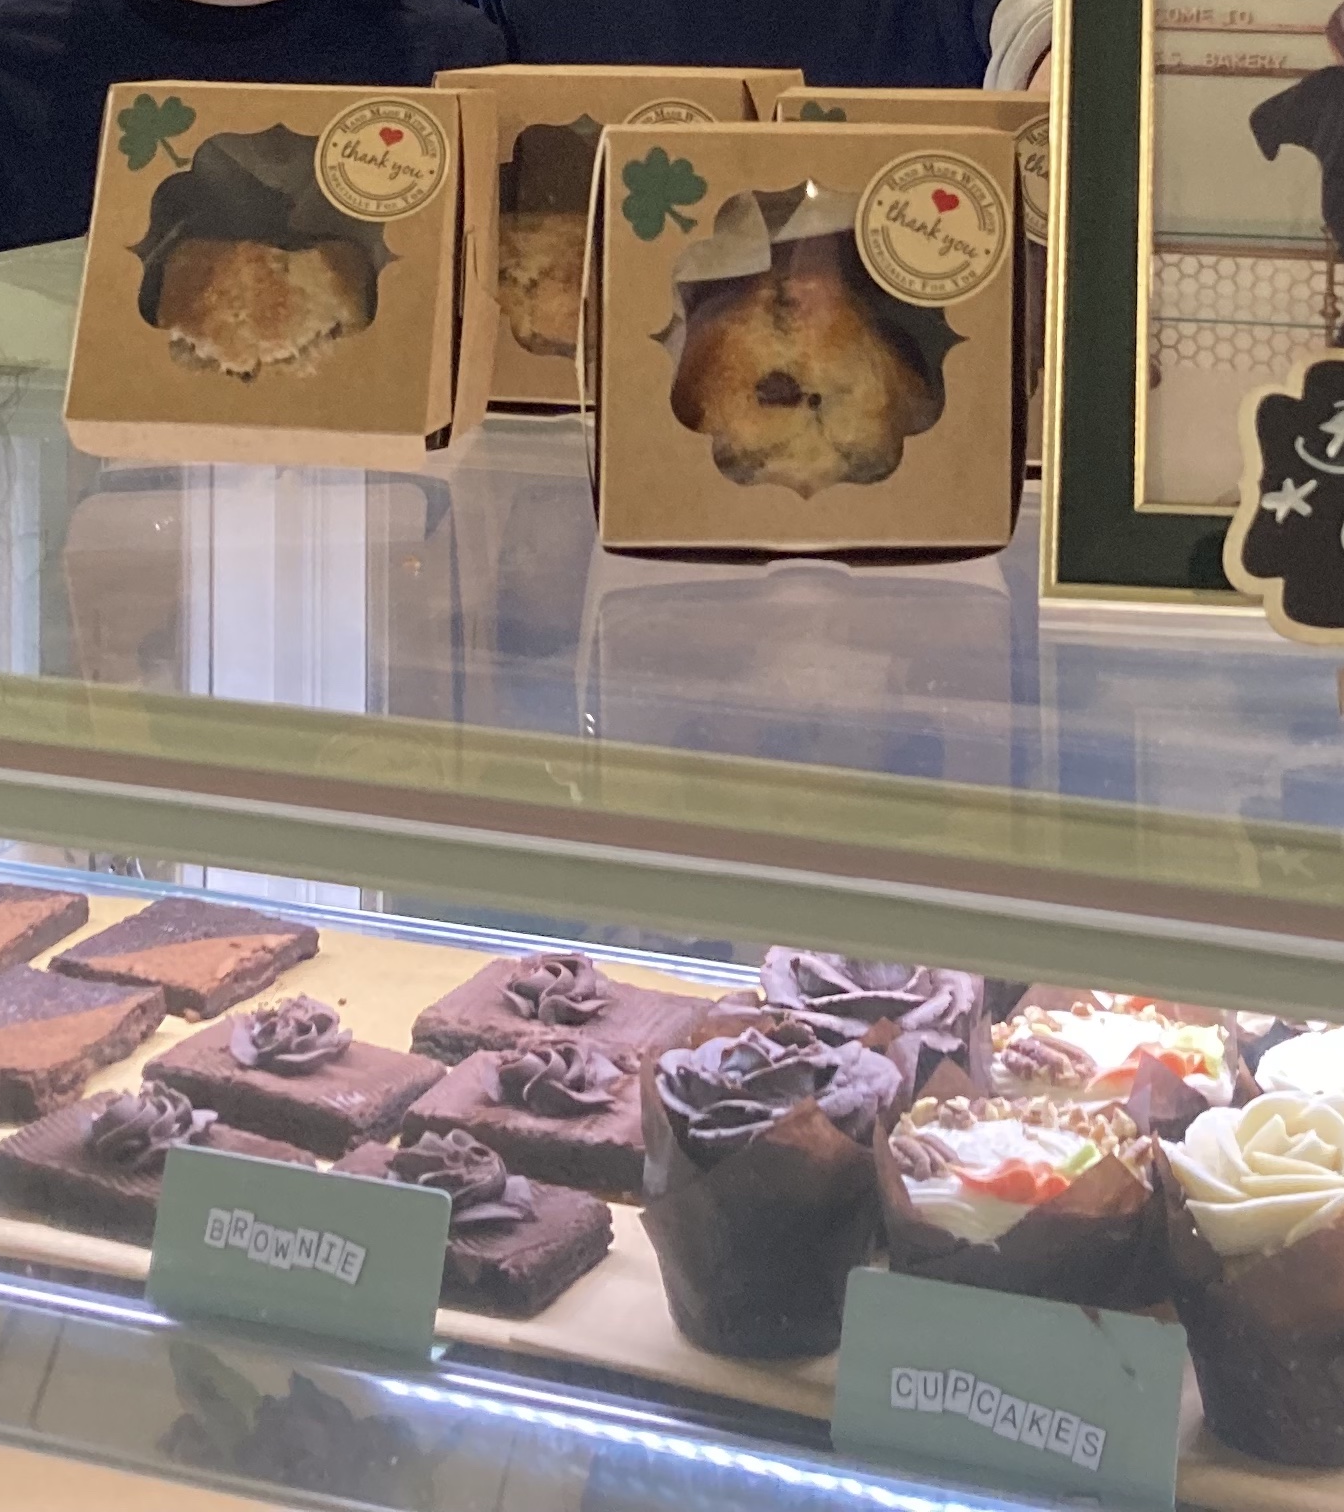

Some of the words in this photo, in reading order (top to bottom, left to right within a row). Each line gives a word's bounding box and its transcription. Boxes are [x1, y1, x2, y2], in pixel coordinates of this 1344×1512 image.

[341, 138, 390, 170] thank
[387, 162, 424, 181] you
[885, 199, 942, 242] thank
[937, 234, 979, 259] you
[208, 1214, 361, 1279] BROWNIE
[895, 1372, 1101, 1460] CUPCAKES
